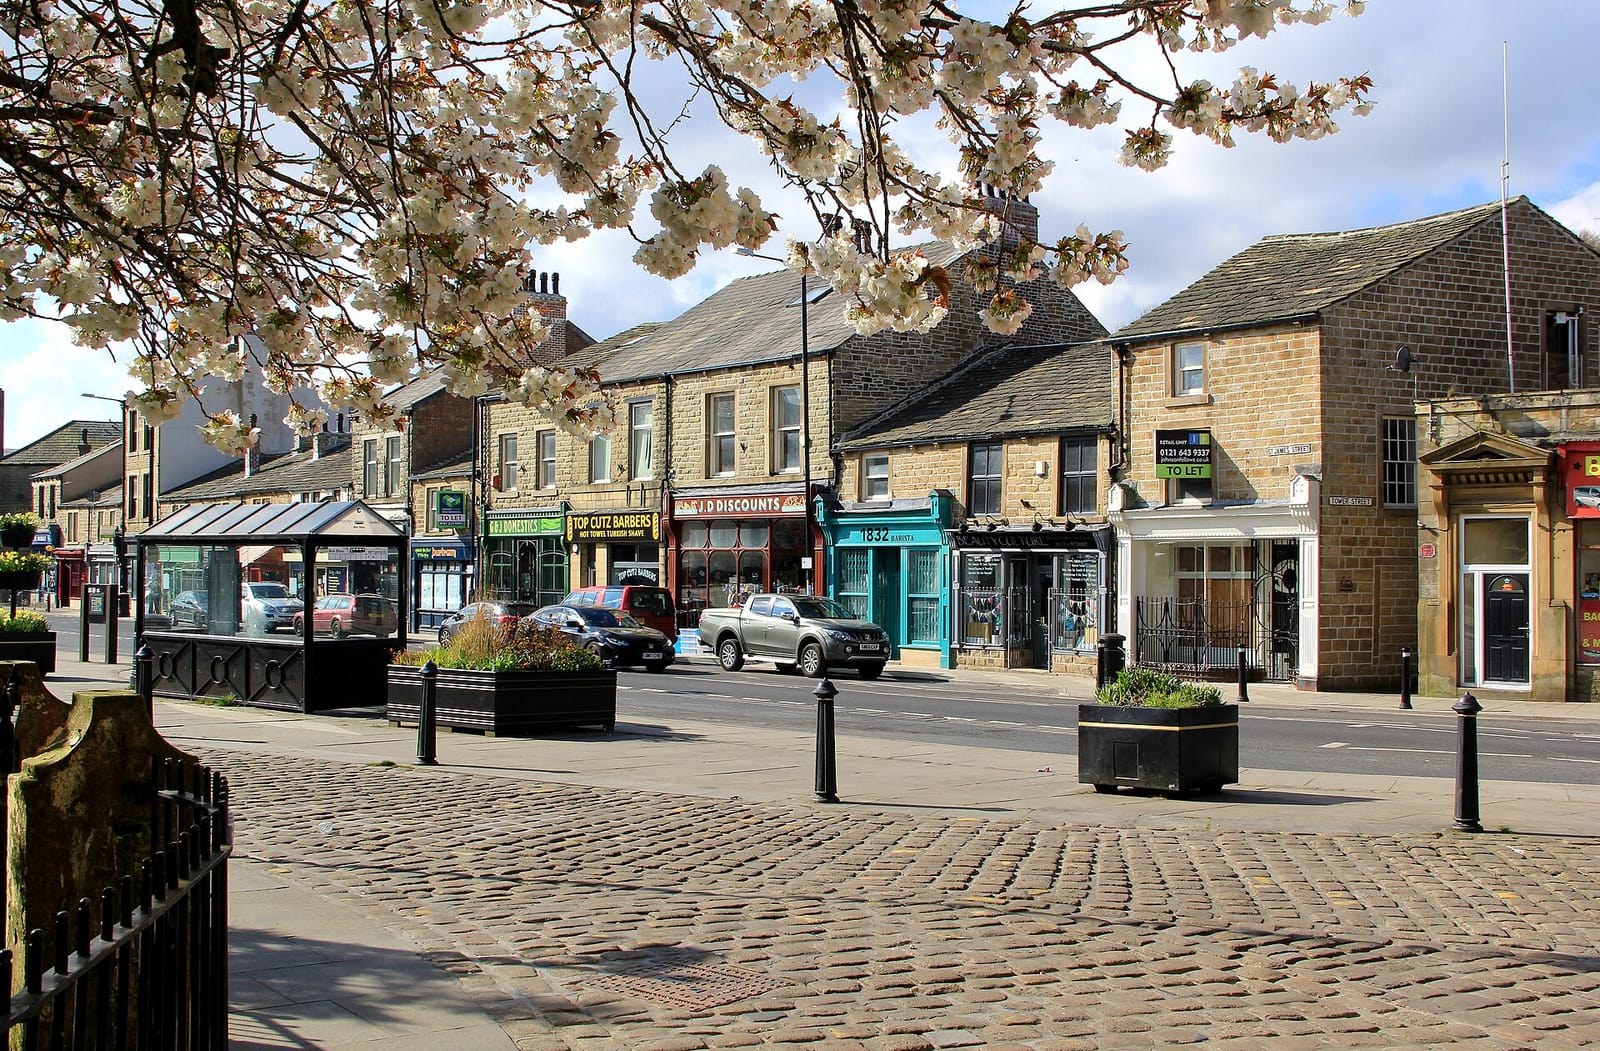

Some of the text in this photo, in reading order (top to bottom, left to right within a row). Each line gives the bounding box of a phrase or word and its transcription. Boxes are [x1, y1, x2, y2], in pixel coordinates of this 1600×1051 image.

[1159, 448, 1210, 456] 0121 643 9337
[1291, 445, 1309, 453] STREET
[1166, 466, 1204, 476] TO LET
[716, 497, 780, 513] DISCOUNTS
[1331, 497, 1349, 505] TOWER
[503, 519, 538, 533] DOMESTICS
[573, 514, 652, 530] TOP CUTZ BARBERS
[628, 529, 645, 537] SHAVE
[860, 527, 888, 542] 1832
[956, 535, 999, 546] BEAUTY
[618, 568, 657, 582] TOP CUTZ BARBERS
